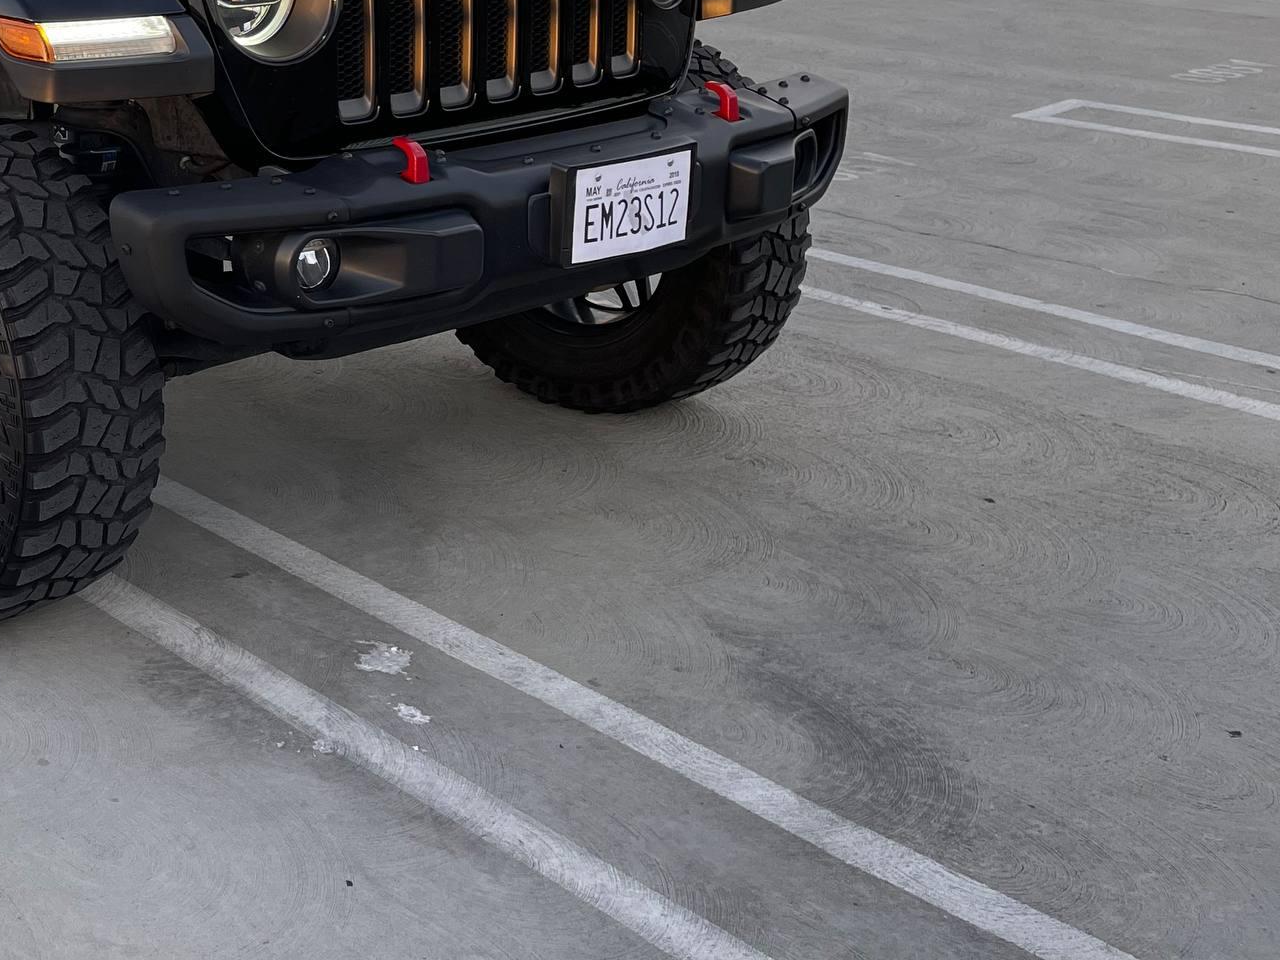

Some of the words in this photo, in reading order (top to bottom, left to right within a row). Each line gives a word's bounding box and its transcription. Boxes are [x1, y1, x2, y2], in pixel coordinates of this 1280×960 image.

[586, 186, 601, 197] MAY
[616, 177, 656, 194] California
[584, 188, 680, 244] EM23S12
